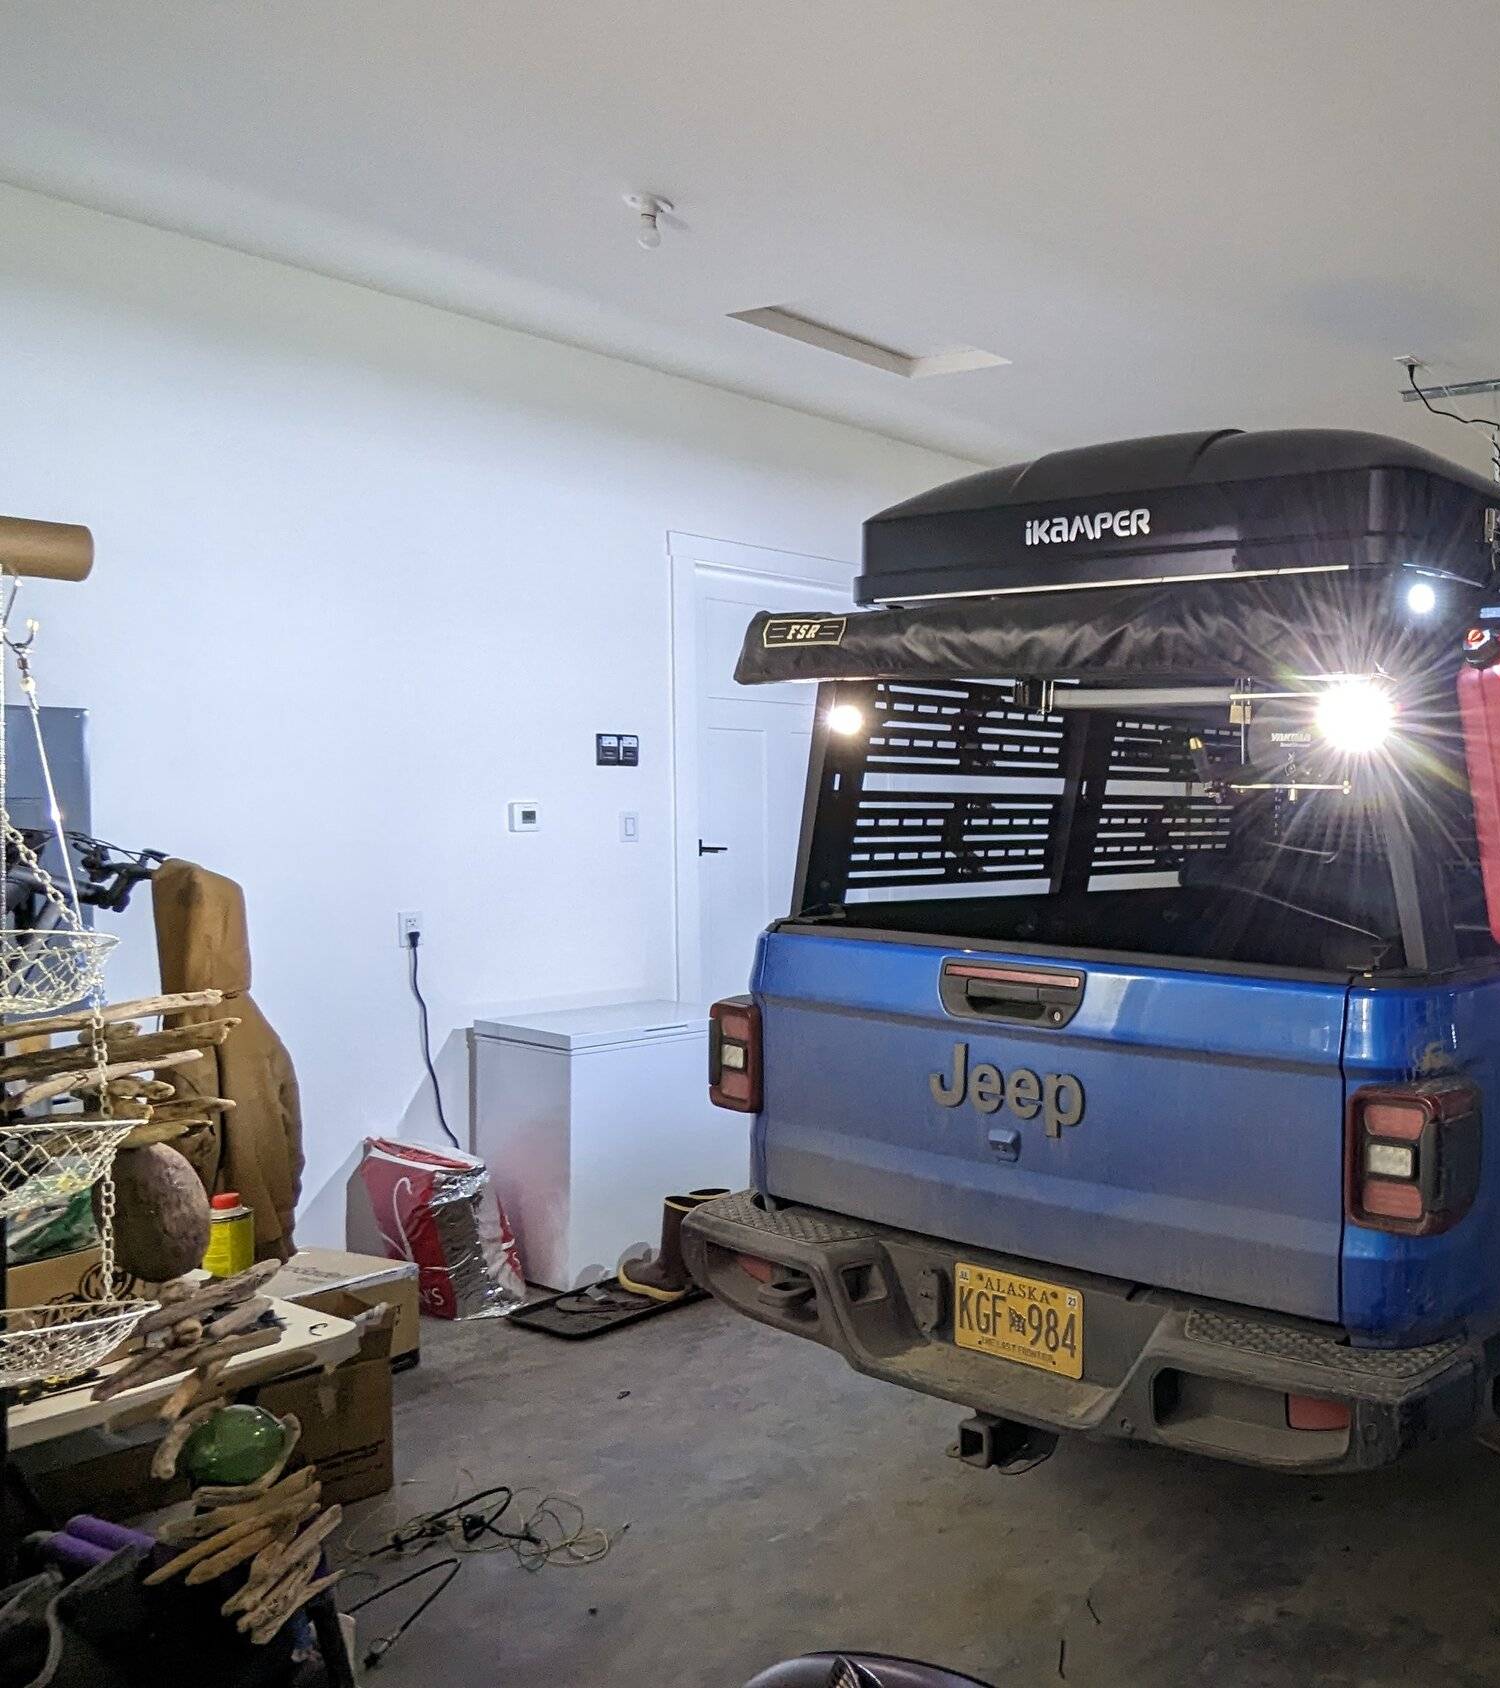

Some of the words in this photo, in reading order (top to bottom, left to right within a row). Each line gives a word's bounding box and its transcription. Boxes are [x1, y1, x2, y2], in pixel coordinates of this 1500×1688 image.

[786, 624, 821, 640] FSR
[928, 1041, 1086, 1138] Jeep
[984, 1277, 1051, 1305] ALASKA
[959, 1285, 1007, 1337] KGF
[1027, 1303, 1077, 1358] 984
